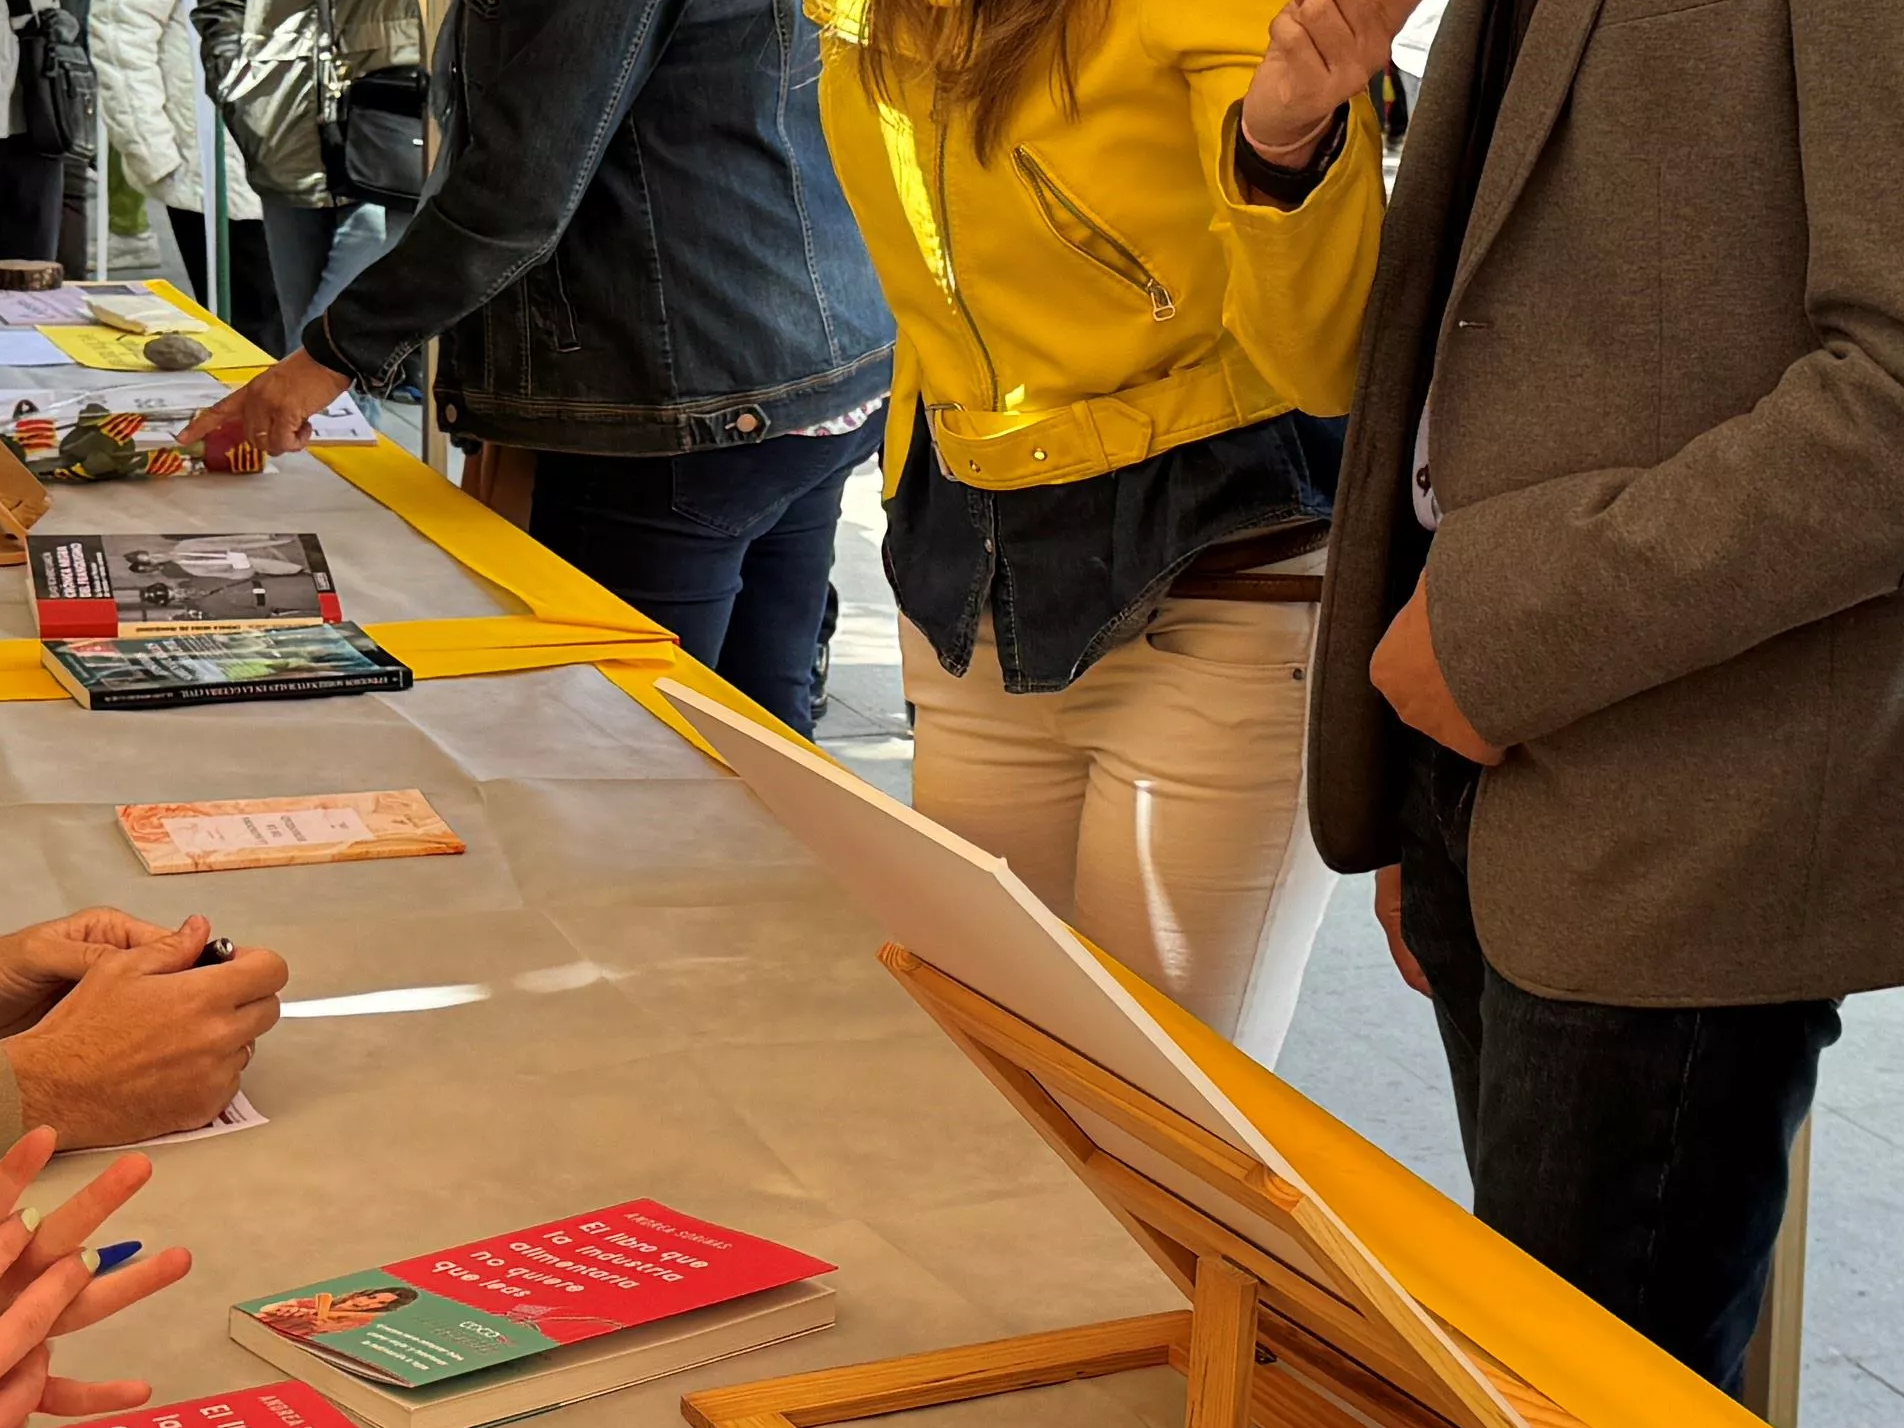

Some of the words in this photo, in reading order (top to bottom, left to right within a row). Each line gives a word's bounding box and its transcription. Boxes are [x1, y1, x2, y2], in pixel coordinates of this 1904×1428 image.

[509, 1241, 641, 1290] alimentaria
[543, 1230, 574, 1246] la
[576, 1244, 686, 1283] industria
[578, 1221, 603, 1235] El
[605, 1232, 658, 1254] libro
[660, 1249, 709, 1270] que
[432, 1259, 480, 1283] que
[478, 1277, 532, 1299] leas
[469, 1250, 505, 1268] no
[507, 1265, 585, 1294] quiere
[199, 1403, 233, 1420] El
